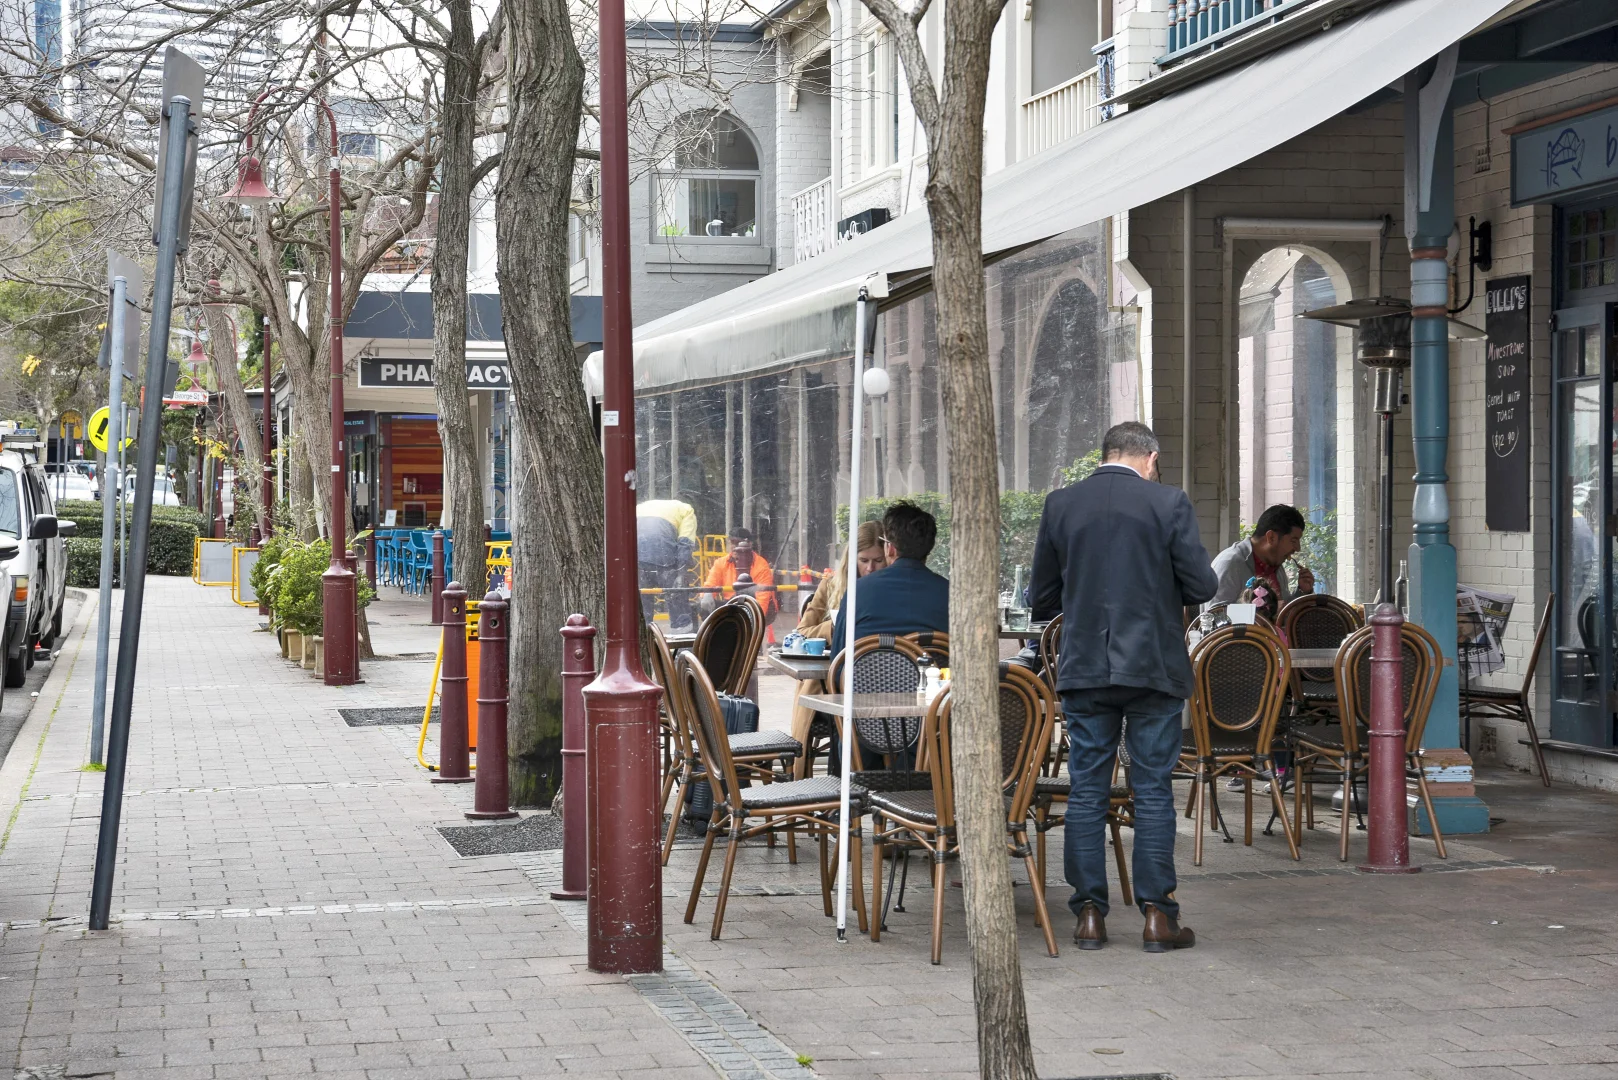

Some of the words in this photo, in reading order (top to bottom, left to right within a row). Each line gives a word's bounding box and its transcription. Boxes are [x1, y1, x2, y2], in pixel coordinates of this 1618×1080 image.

[1486, 285, 1526, 313] BILLI'S
[380, 363, 512, 383] PHAACY
[1498, 365, 1515, 378] SOUP
